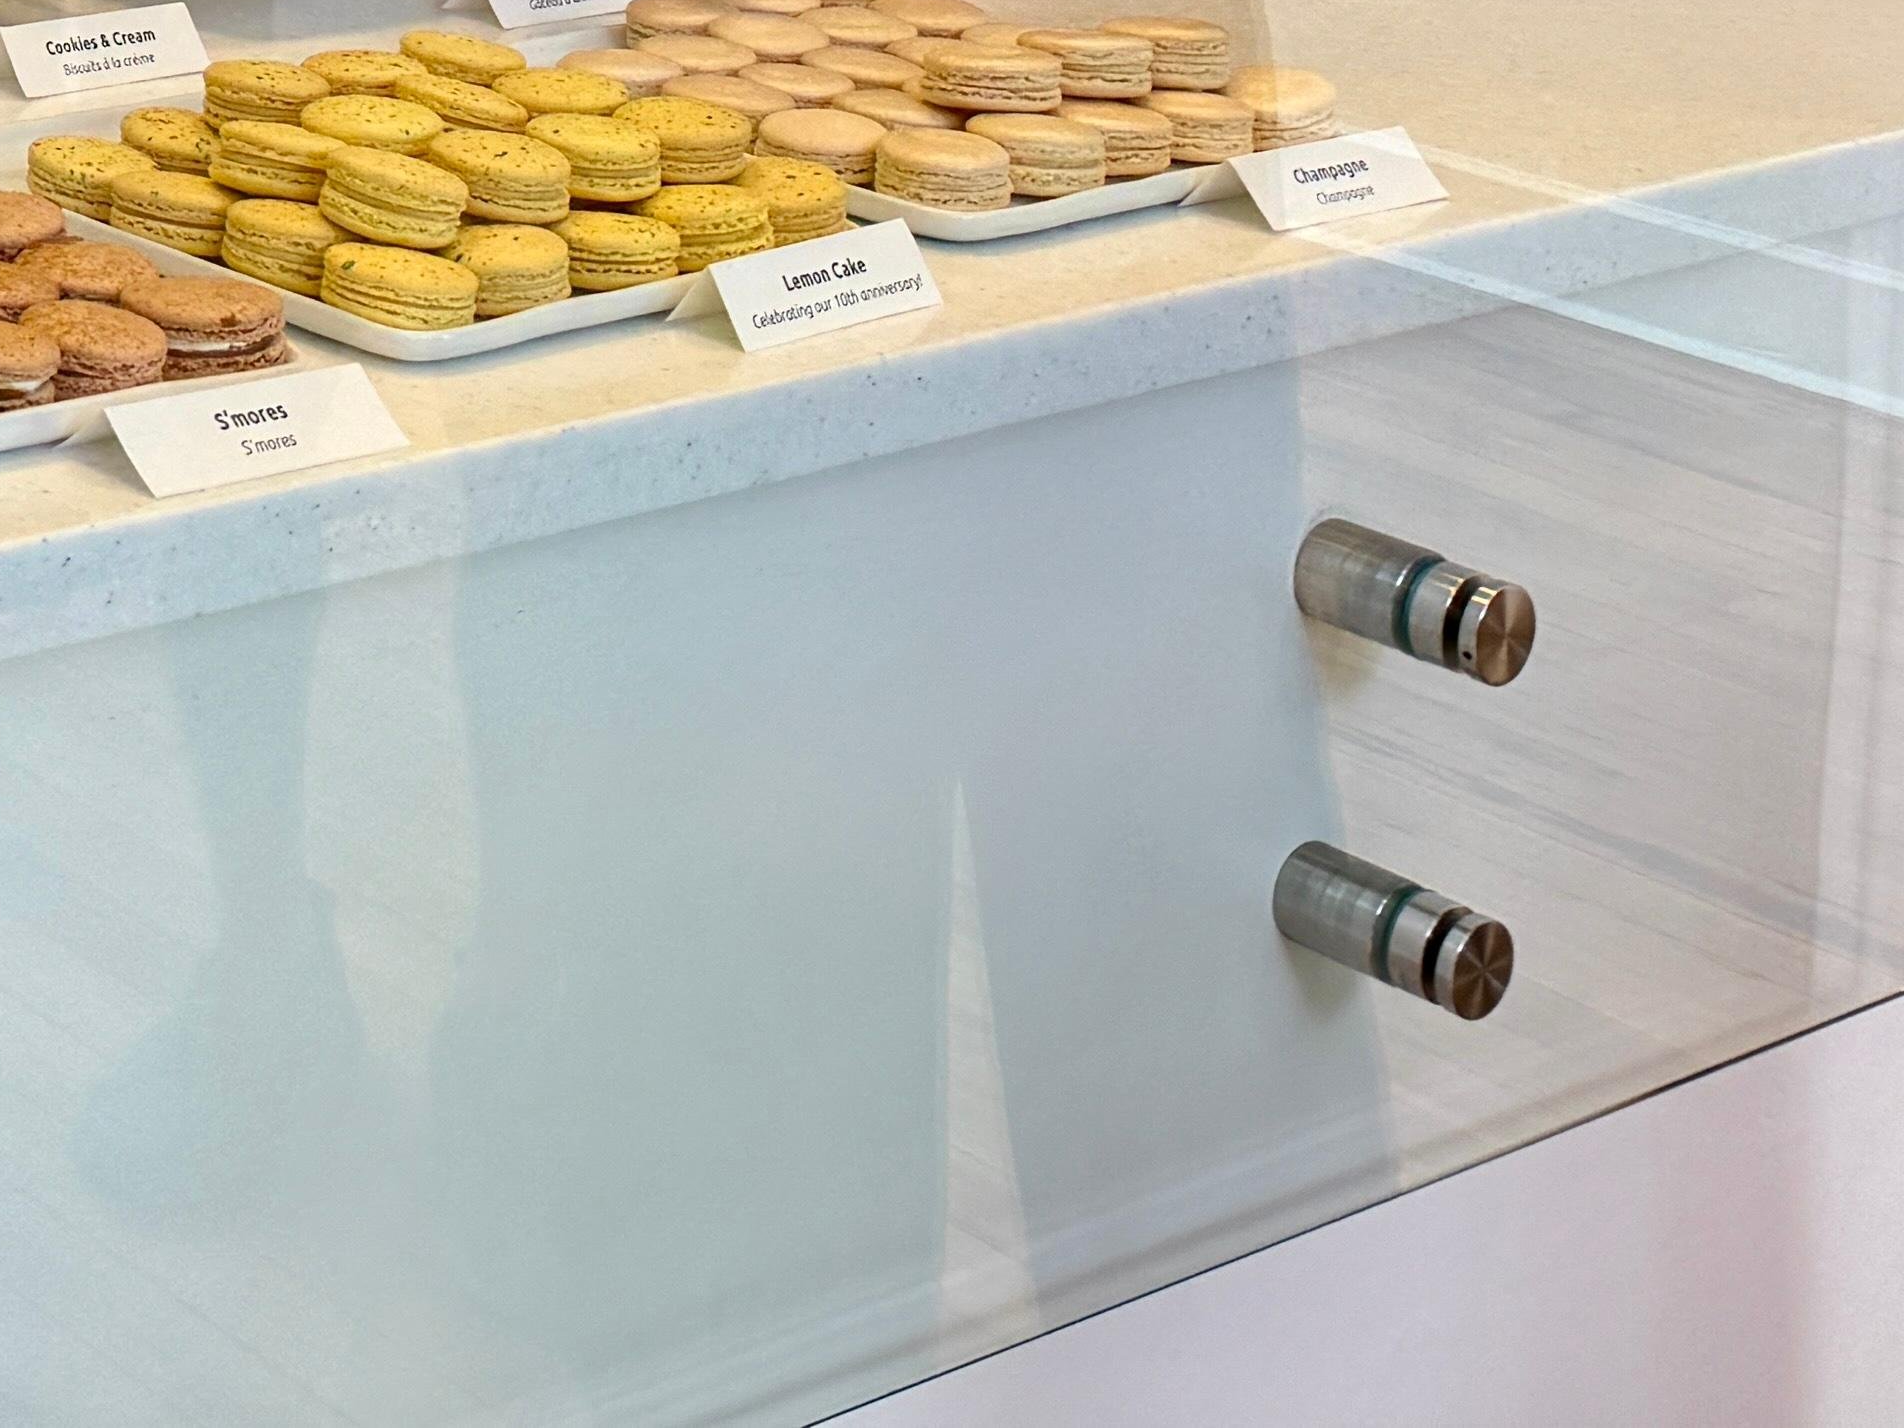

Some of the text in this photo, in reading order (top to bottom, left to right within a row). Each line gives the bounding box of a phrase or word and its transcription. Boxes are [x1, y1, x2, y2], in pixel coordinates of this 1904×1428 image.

[46, 28, 156, 56] Cookies & Cream
[64, 59, 102, 76] Biscuits
[112, 55, 122, 68] la
[1293, 158, 1369, 184] Champagne
[1316, 185, 1375, 205] Champagne
[782, 257, 867, 291] Lemon Cake
[752, 273, 923, 329] Celebrating our 10th anniversary!
[214, 403, 288, 431] S'mores
[241, 433, 297, 456] S'mores
